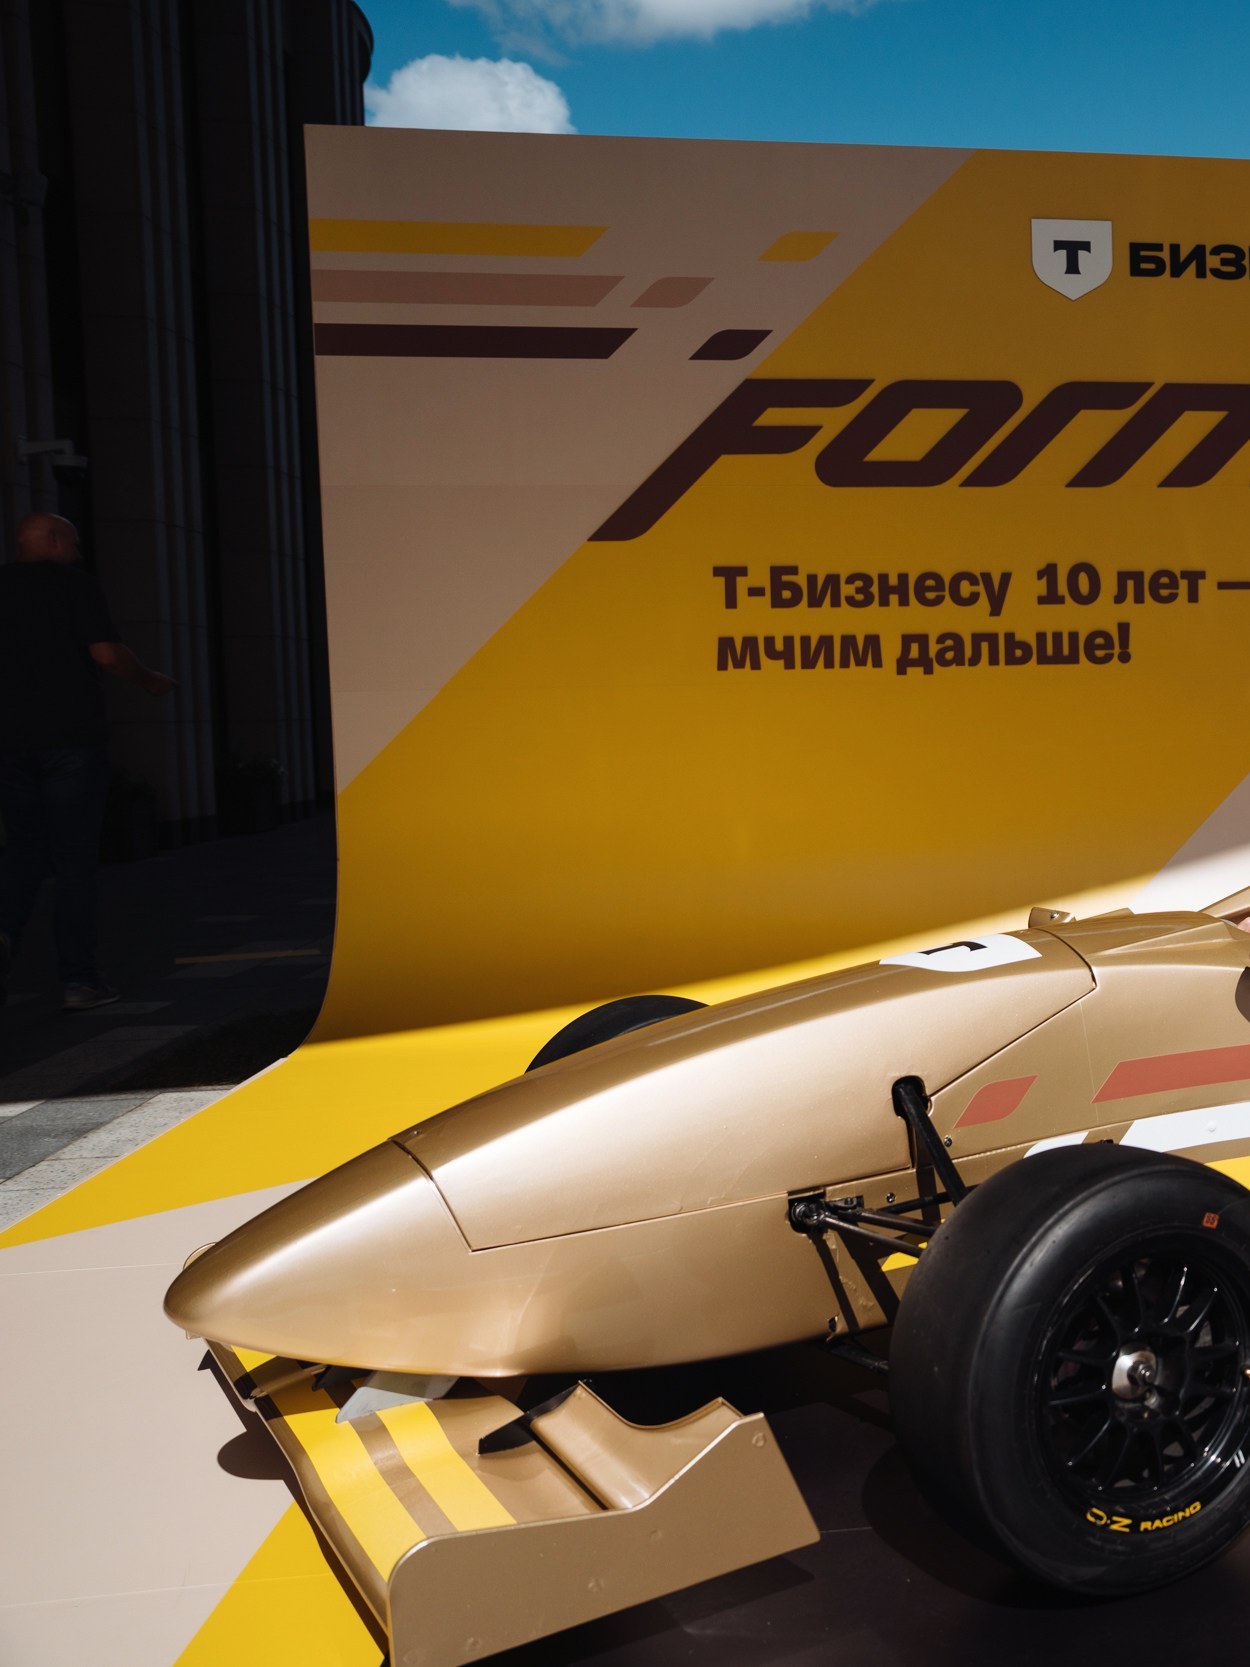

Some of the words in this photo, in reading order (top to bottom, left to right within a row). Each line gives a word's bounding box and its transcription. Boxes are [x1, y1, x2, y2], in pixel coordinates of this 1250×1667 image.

[712, 565, 1013, 617] Т-Бизнесу
[1036, 562, 1102, 606] 10
[716, 634, 883, 672] мчим
[896, 622, 1132, 676] дальше!
[1139, 1501, 1202, 1532] RACING
